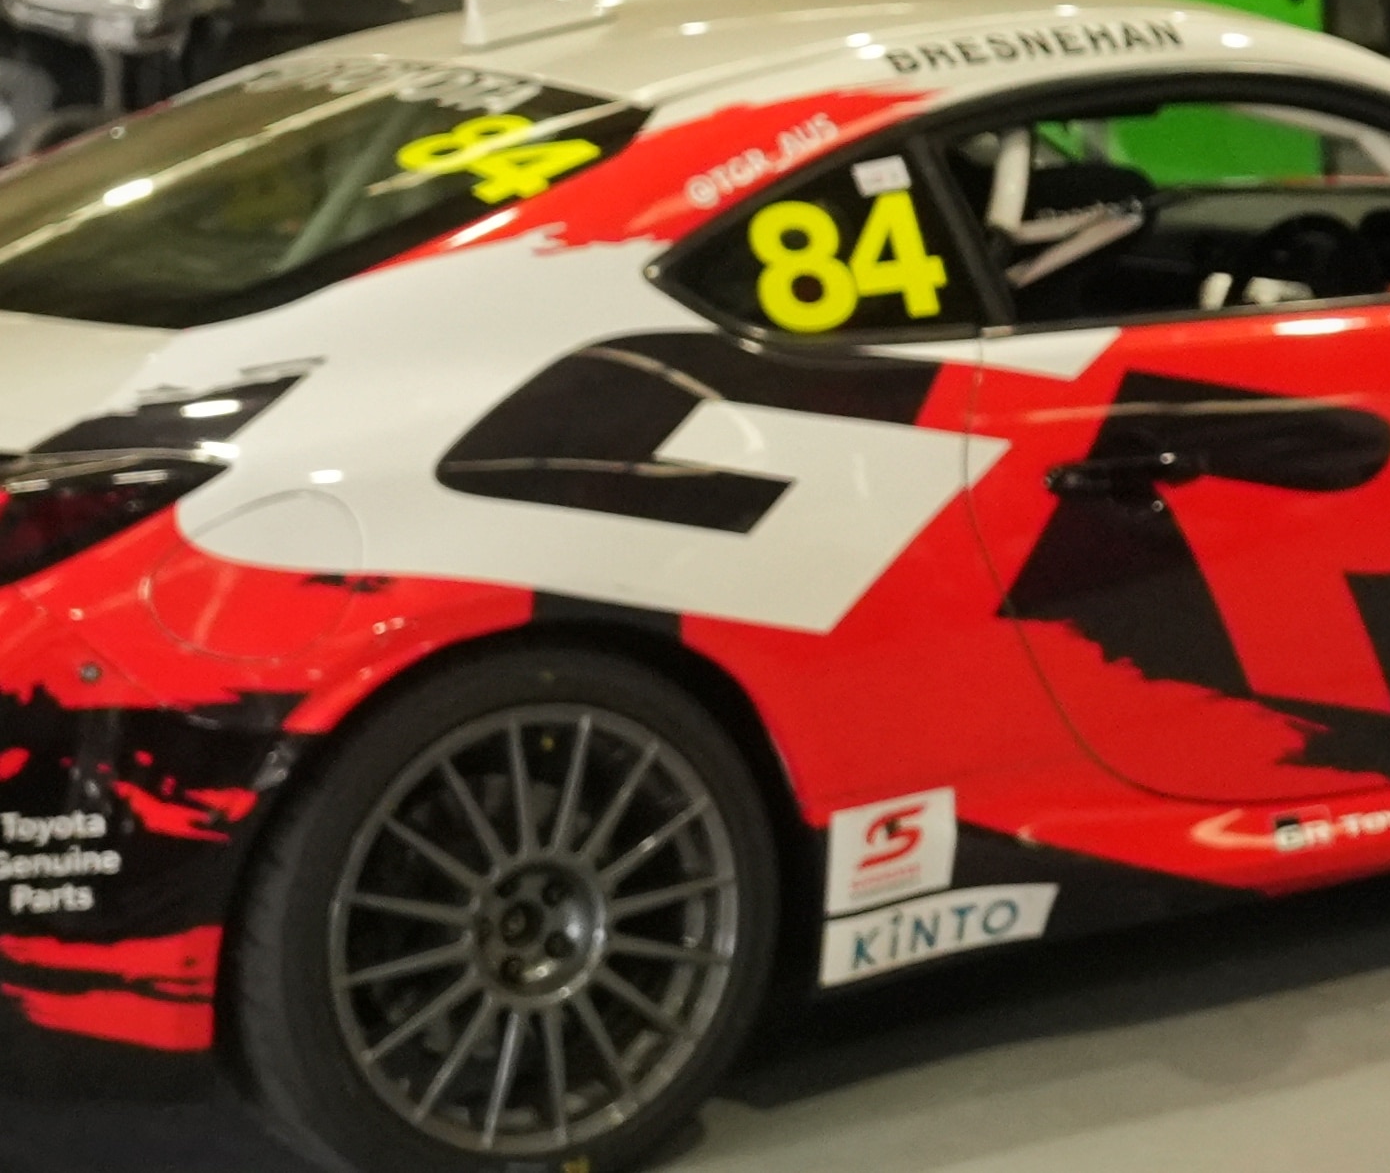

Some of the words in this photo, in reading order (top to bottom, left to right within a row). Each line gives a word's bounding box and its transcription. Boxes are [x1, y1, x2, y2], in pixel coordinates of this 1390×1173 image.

[886, 20, 1185, 74] BRESNEHAN
[396, 113, 601, 204] 84
[747, 189, 948, 334] 84
[0, 810, 107, 847] Toyota
[10, 882, 94, 915] Parts
